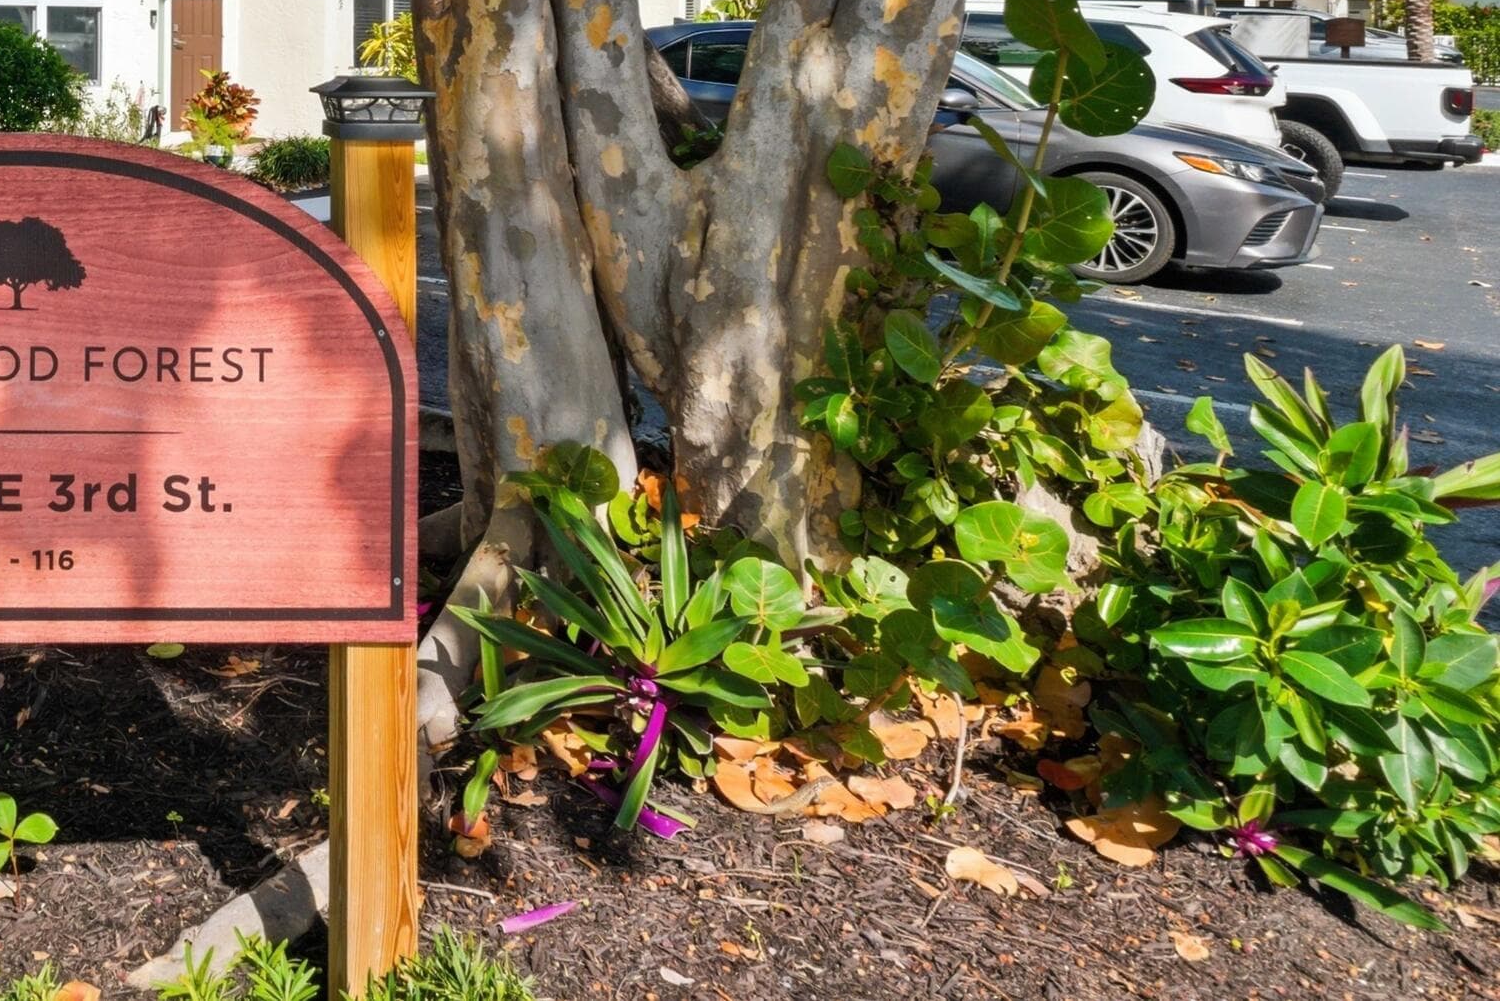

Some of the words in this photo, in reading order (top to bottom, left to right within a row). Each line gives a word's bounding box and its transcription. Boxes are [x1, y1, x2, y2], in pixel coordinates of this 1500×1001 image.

[85, 346, 273, 383] FOREST
[48, 474, 137, 512] 3rd
[163, 474, 232, 512] St.
[33, 550, 74, 570] 116
